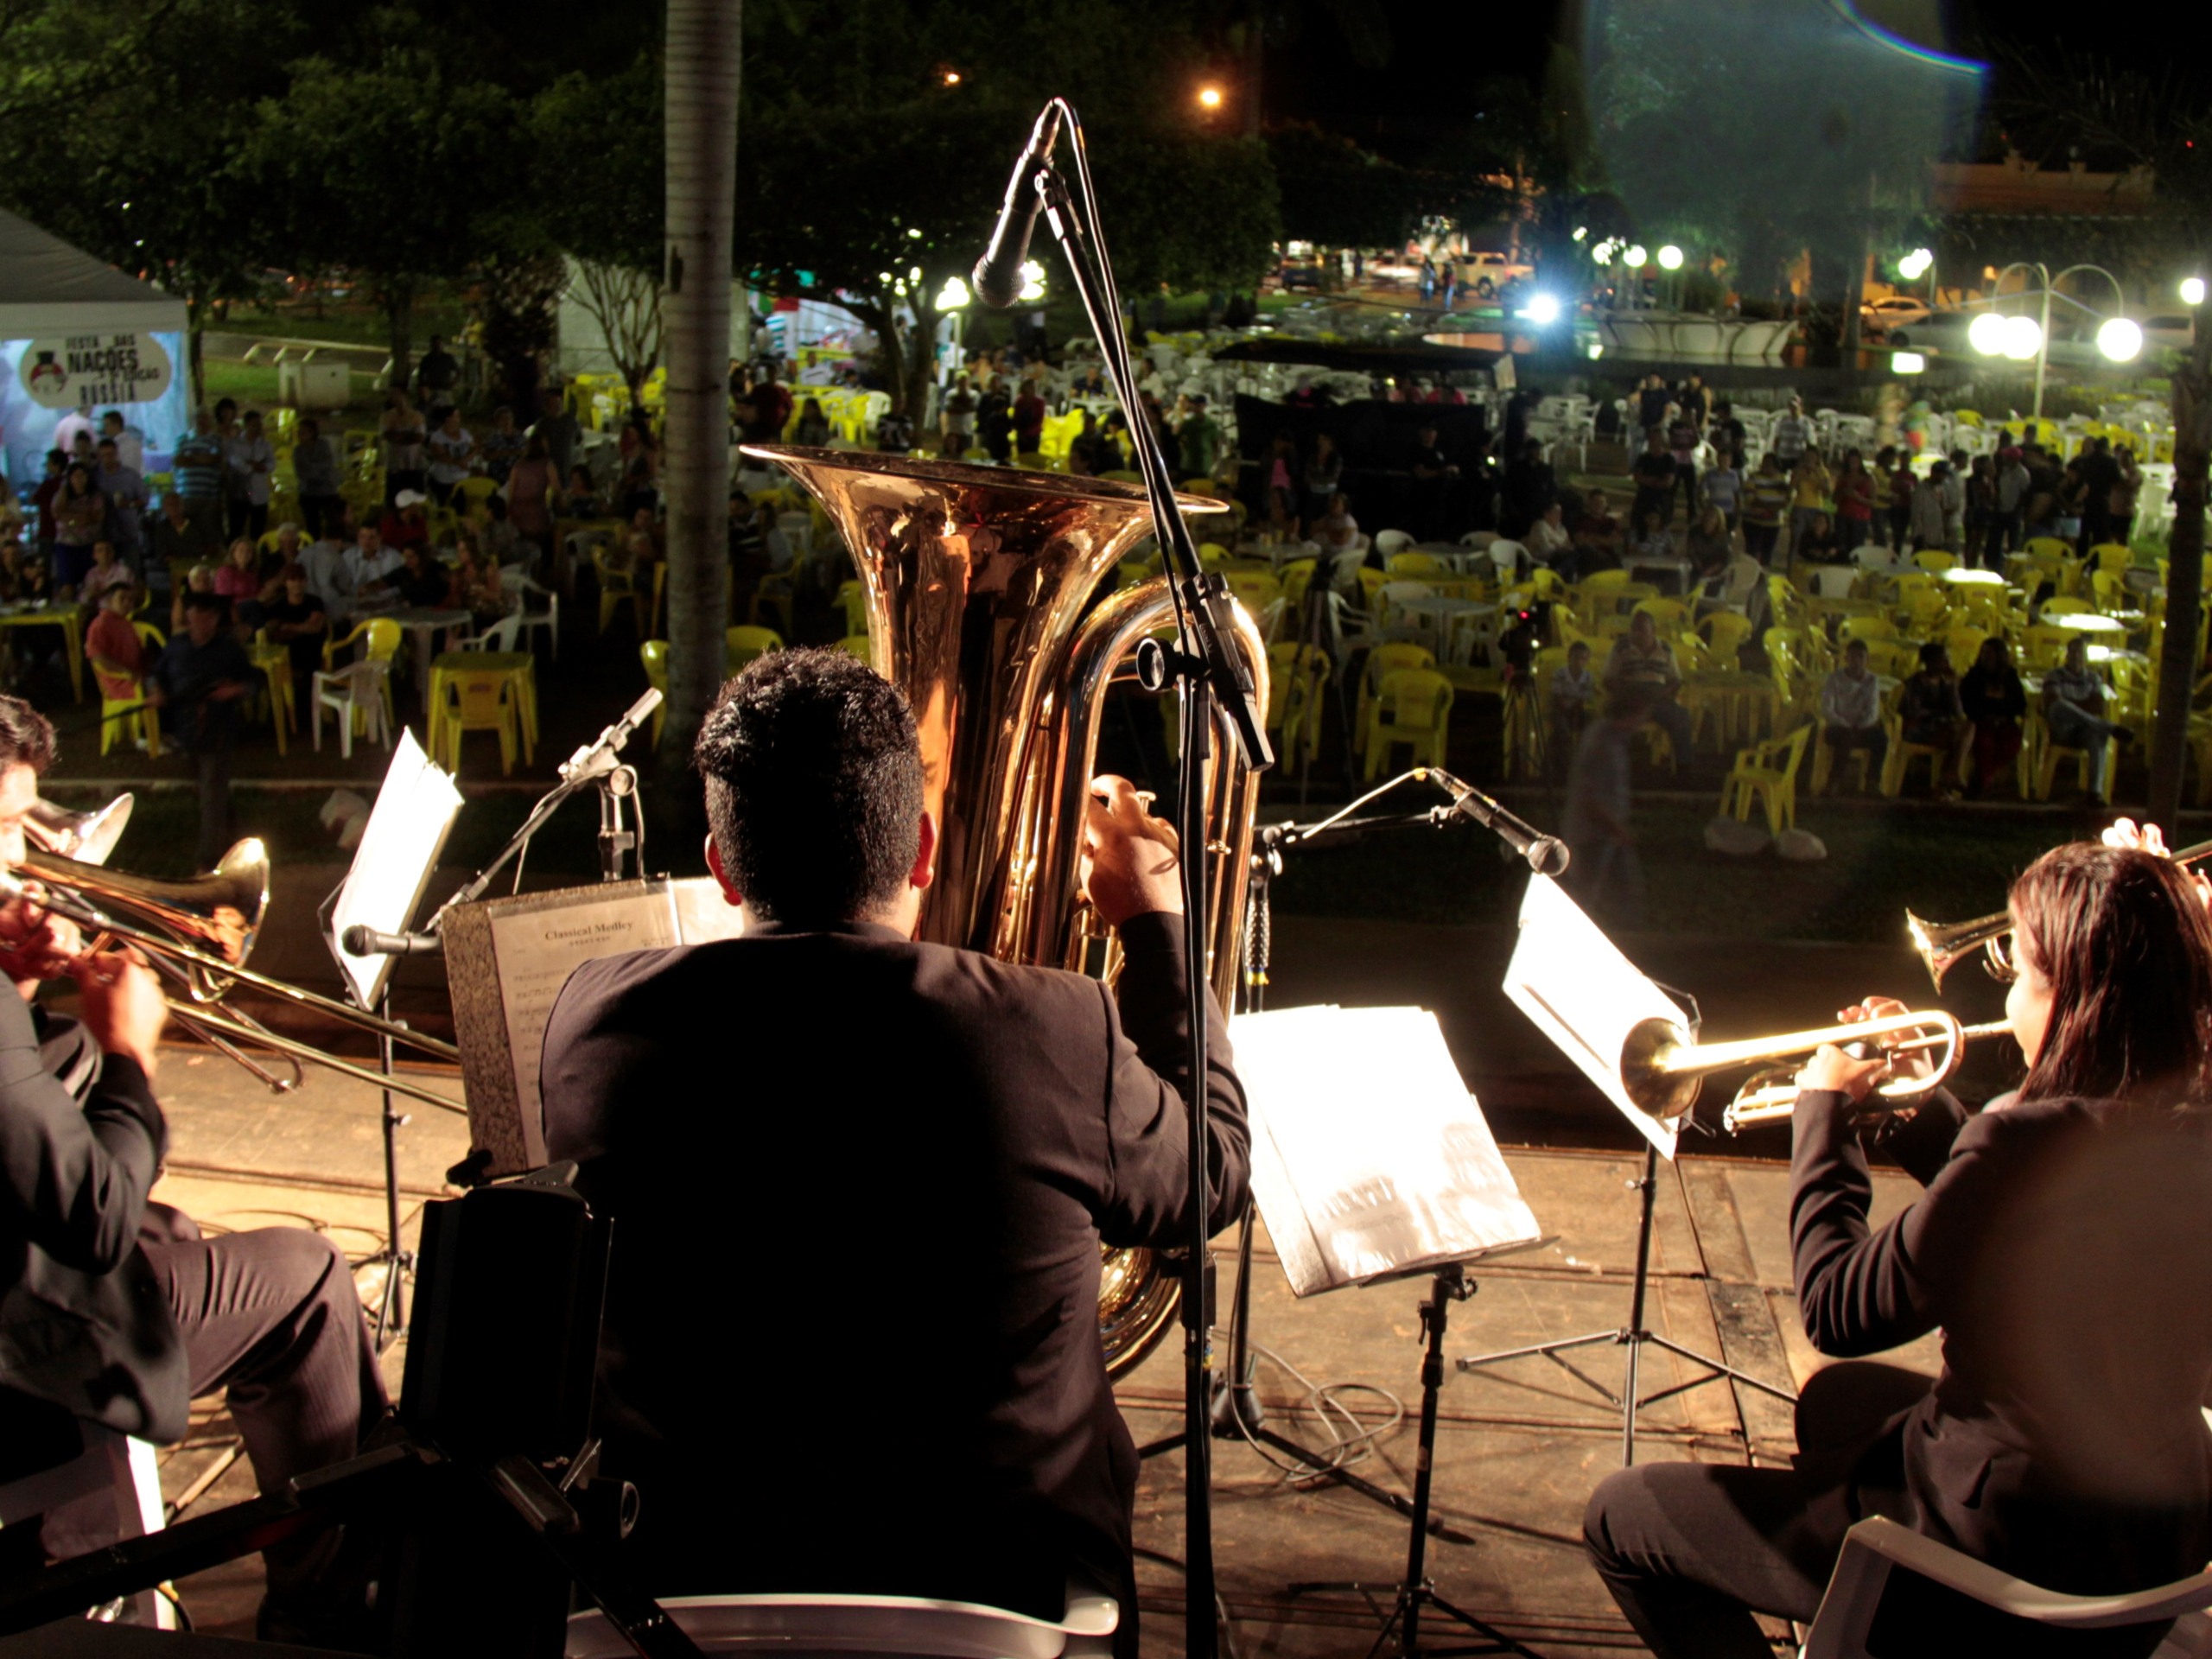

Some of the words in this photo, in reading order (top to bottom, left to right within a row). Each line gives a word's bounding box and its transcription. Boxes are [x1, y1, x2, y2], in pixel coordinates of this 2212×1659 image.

[66, 336, 99, 349] FESTA
[113, 334, 136, 346] DAS
[67, 347, 138, 375] NAÇÕES
[544, 925, 592, 941] Classical
[594, 919, 633, 934] Medley
